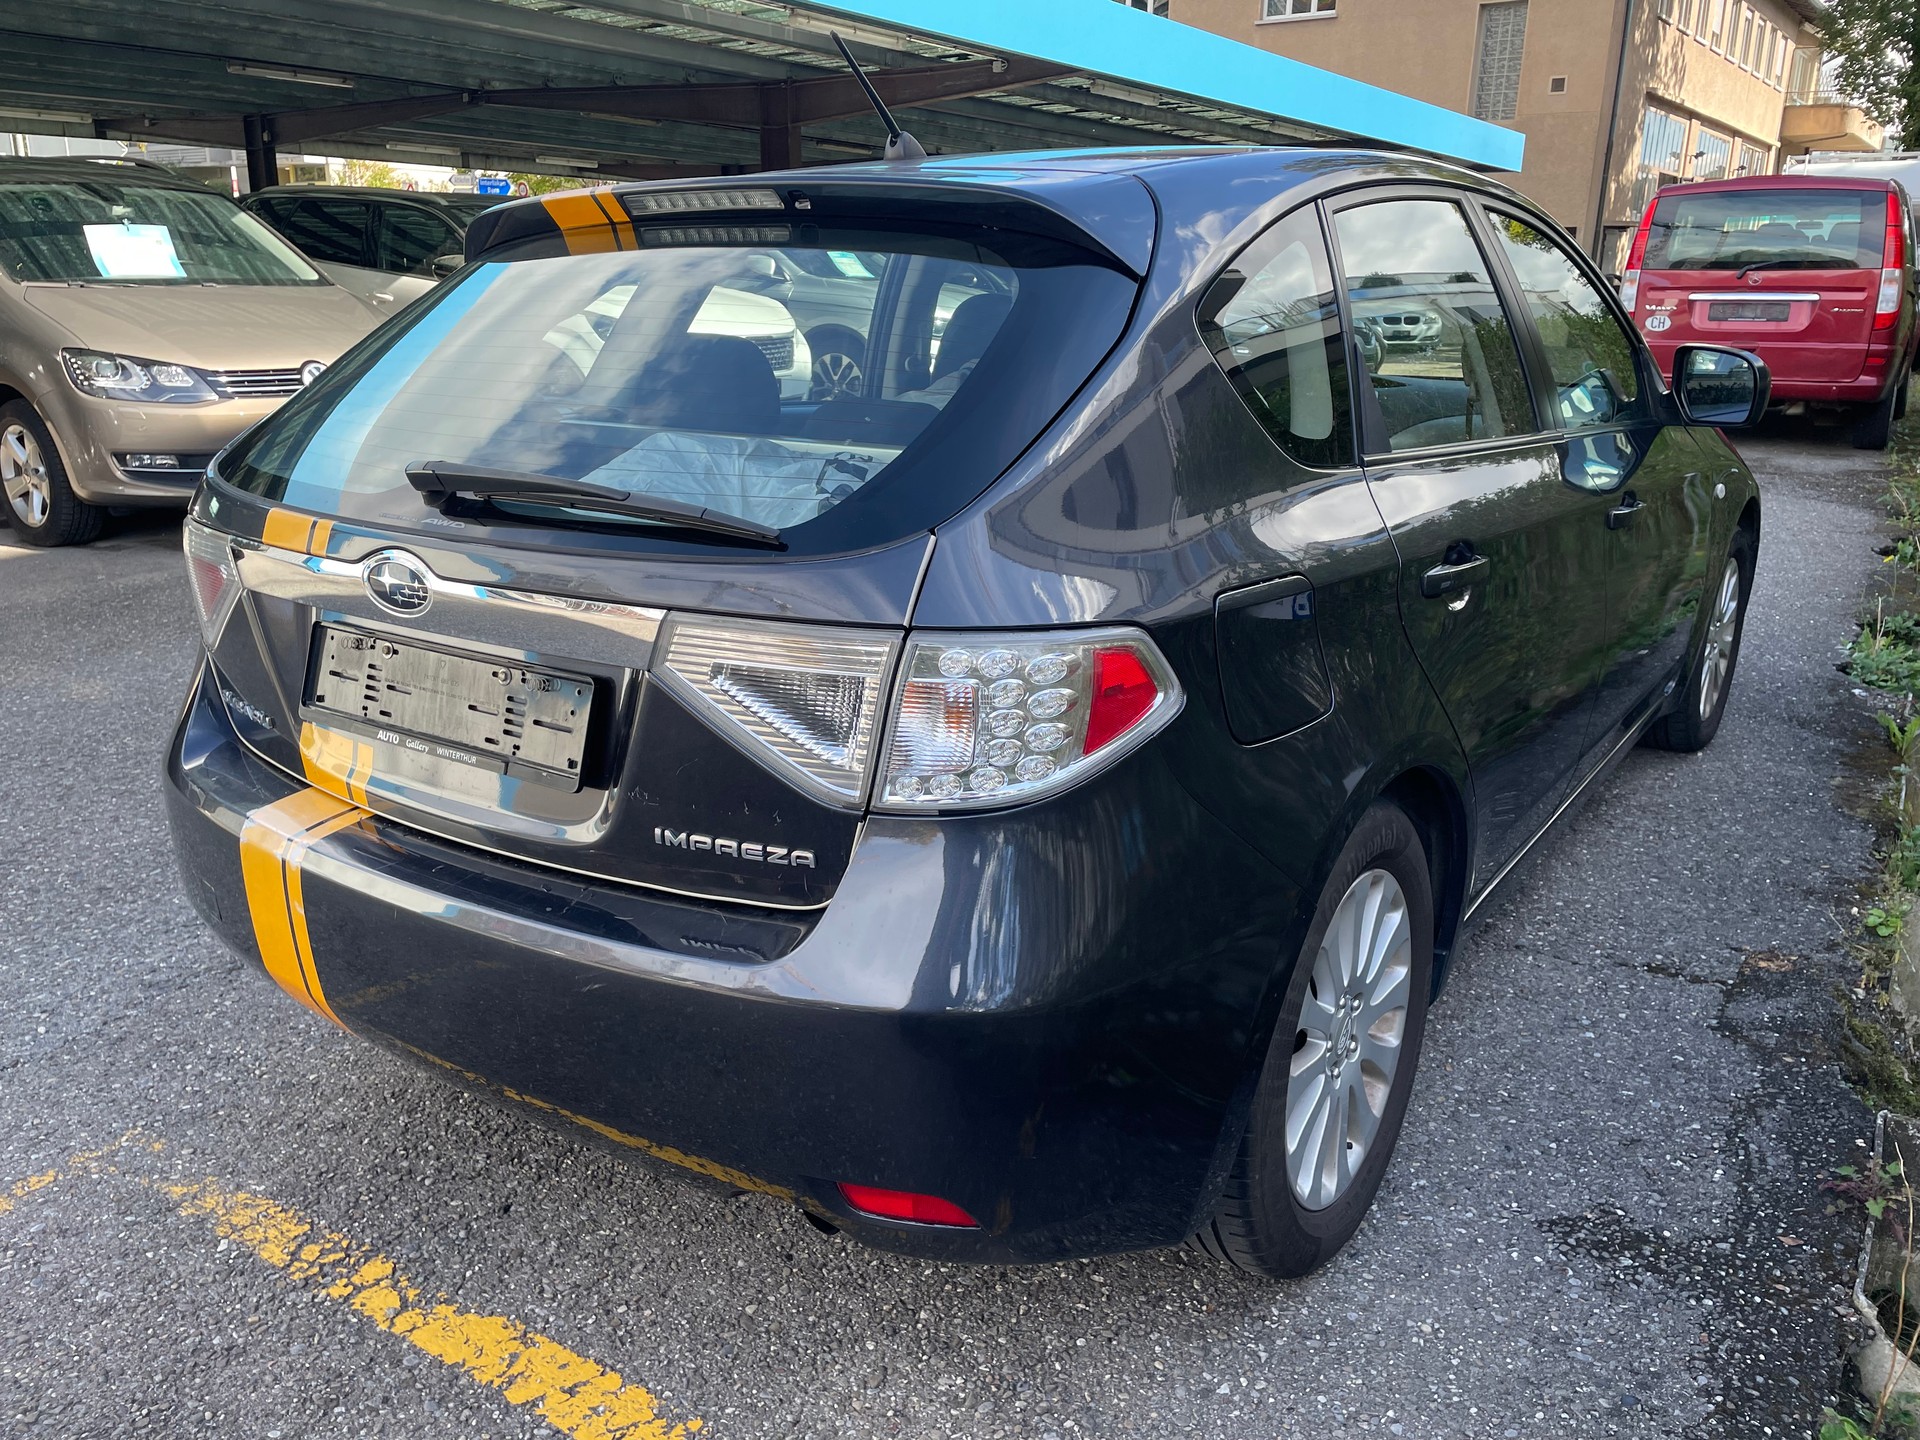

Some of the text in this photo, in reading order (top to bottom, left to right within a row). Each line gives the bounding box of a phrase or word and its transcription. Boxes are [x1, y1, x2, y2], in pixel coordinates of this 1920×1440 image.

[1651, 317, 1666, 329] CH
[420, 518, 466, 529] AWD
[377, 730, 477, 764] AUTO Gallery WINTERTHUR
[654, 826, 818, 869] IMPREZA
